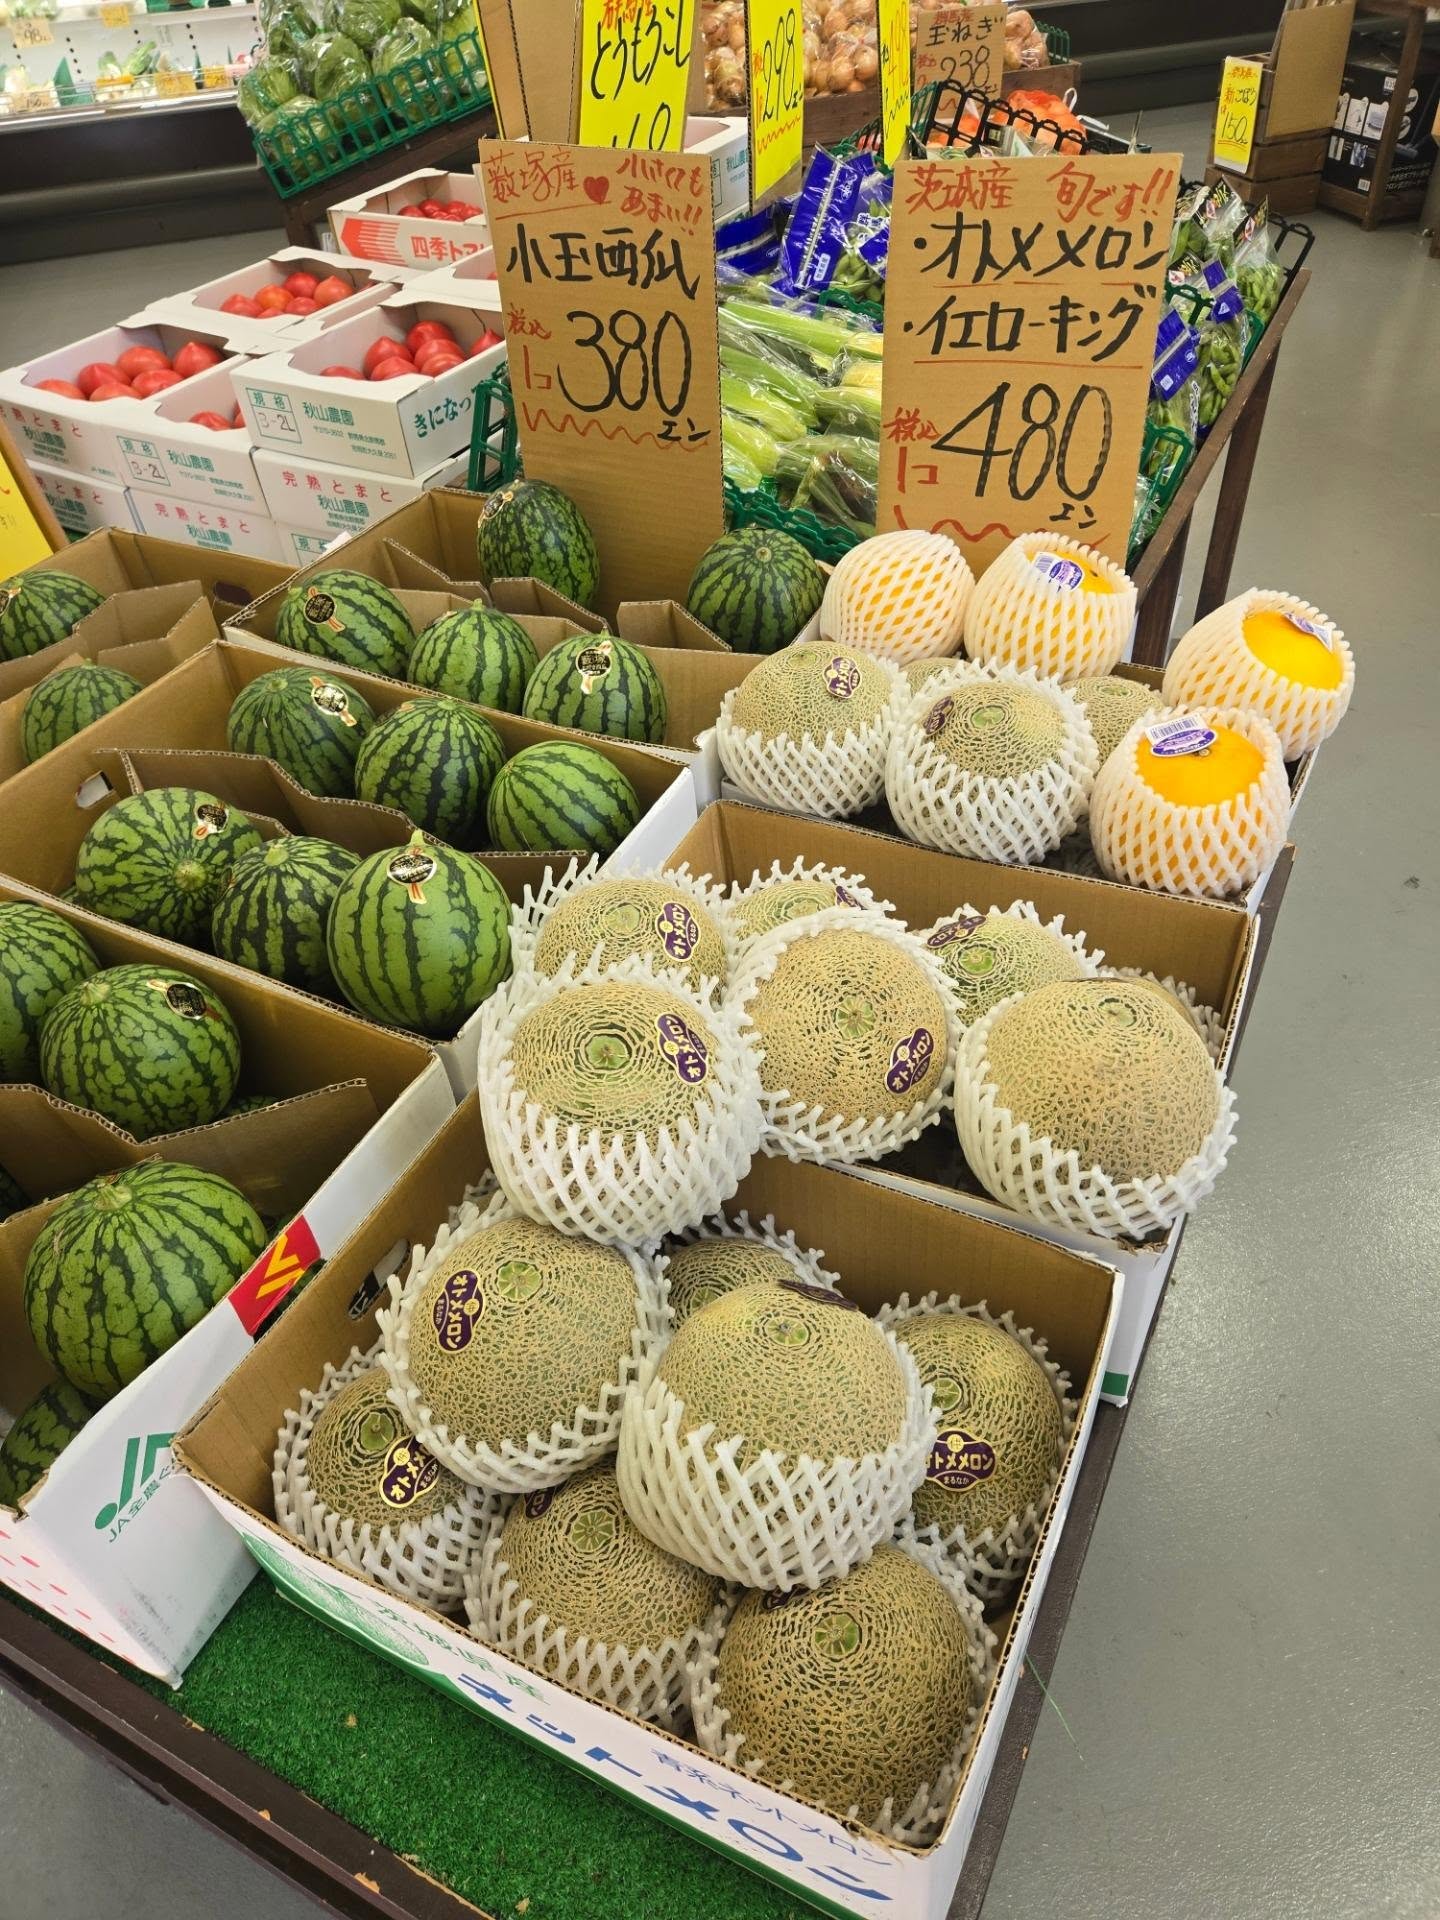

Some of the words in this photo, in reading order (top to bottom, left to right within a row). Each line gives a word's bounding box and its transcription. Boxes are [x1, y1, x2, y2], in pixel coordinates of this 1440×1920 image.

[926, 16, 1003, 47] 玉ねぎ
[763, 8, 796, 122] 298
[940, 45, 990, 89] 238
[1221, 112, 1247, 142] 150
[905, 160, 1019, 214] 茨城産
[506, 222, 700, 300] 小玉西瓜
[556, 309, 692, 417] 380
[302, 401, 355, 427] 秋山農園
[657, 417, 711, 442] エン
[884, 406, 941, 442] 税込
[930, 381, 1113, 501] 480
[282, 470, 393, 503] 完熟とまと
[317, 493, 370, 518] 秋山農園
[154, 501, 251, 534] 完熟とまと
[186, 523, 233, 546] 秋山農園
[1049, 502, 1097, 530] エン
[672, 903, 688, 957] オトメメロン
[665, 1015, 702, 1079] オトメメロン
[892, 1032, 931, 1091] オトメメロン
[446, 1273, 468, 1348] オトメメロン
[457, 1672, 894, 1901] ネットメロン
